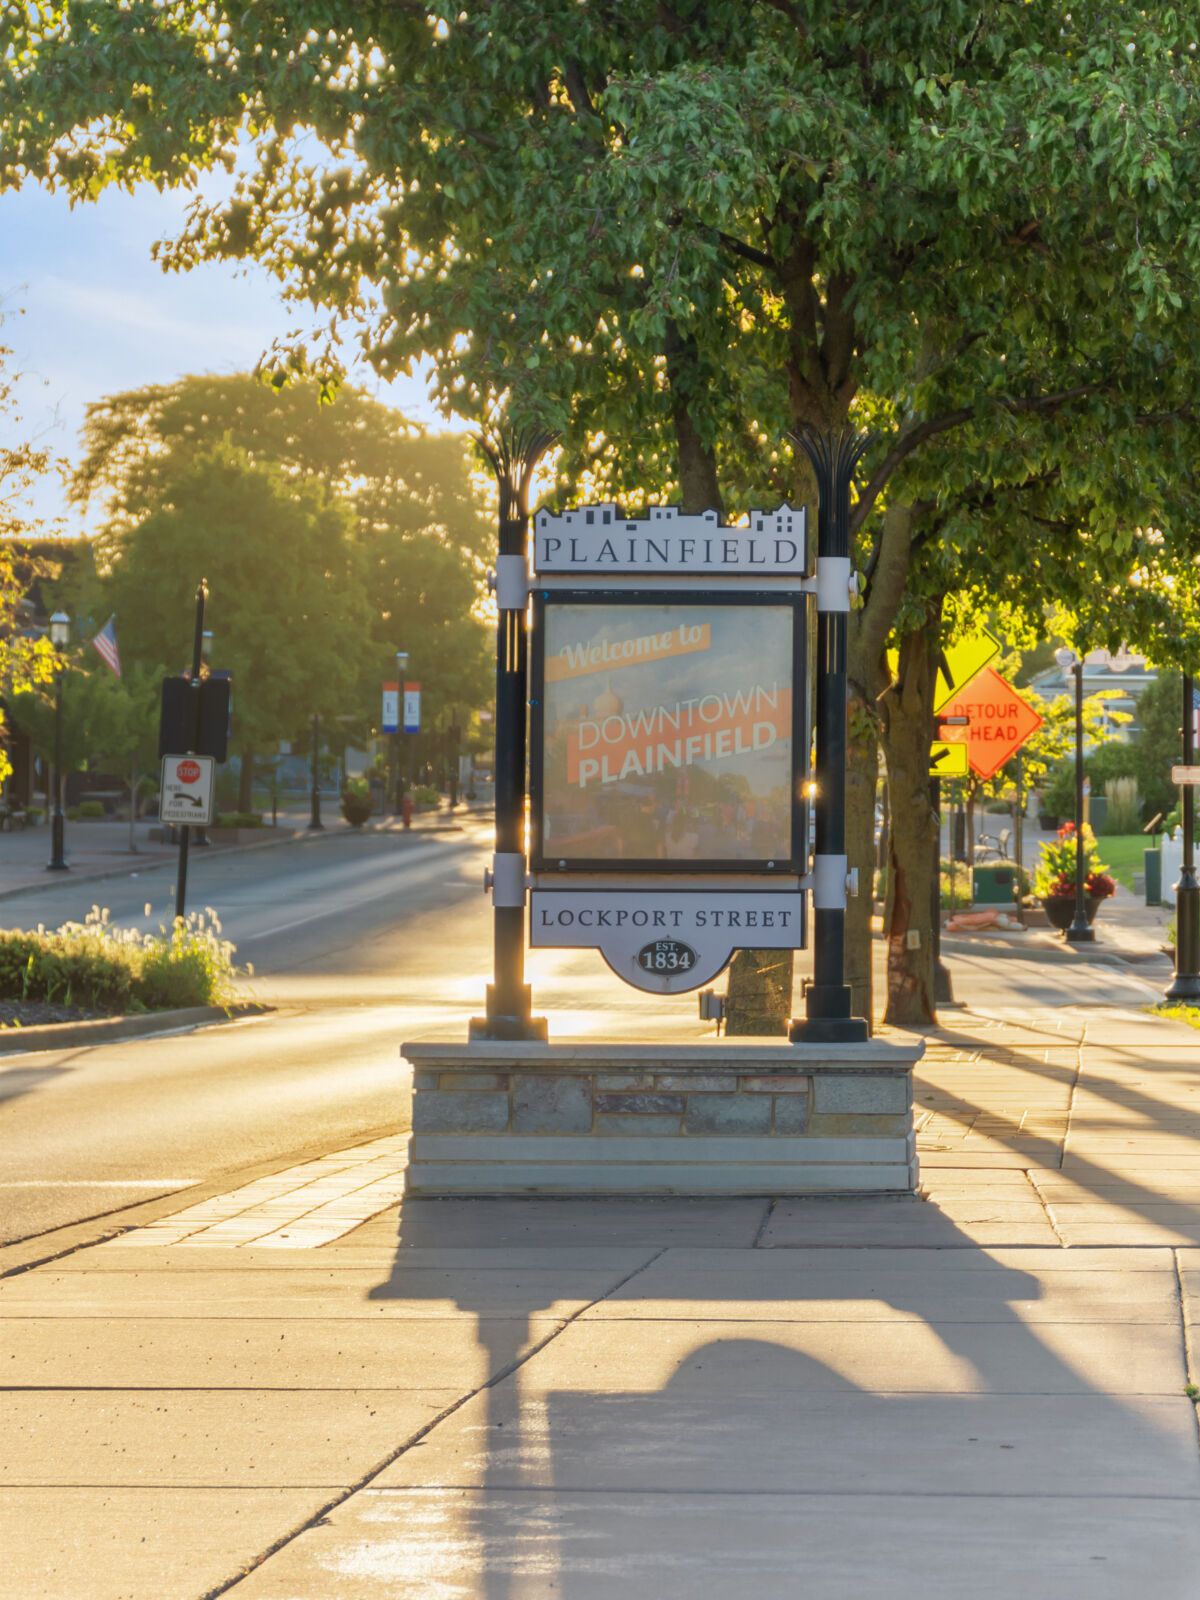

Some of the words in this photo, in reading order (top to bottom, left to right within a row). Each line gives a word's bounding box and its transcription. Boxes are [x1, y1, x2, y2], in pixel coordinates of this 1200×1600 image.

[542, 537, 798, 564] PLAINFIELD
[559, 630, 673, 670] Welcome
[679, 623, 704, 646] to
[578, 681, 778, 751] DOWNTOWN
[953, 703, 1019, 719] DETOUR
[970, 725, 1018, 741] HEAD
[578, 721, 778, 789] PLAINFIELD
[177, 767, 201, 776] STOP
[541, 909, 684, 927] LOCKPORT
[695, 910, 792, 928] STREET
[655, 942, 679, 952] EST.
[643, 952, 691, 970] 1834
